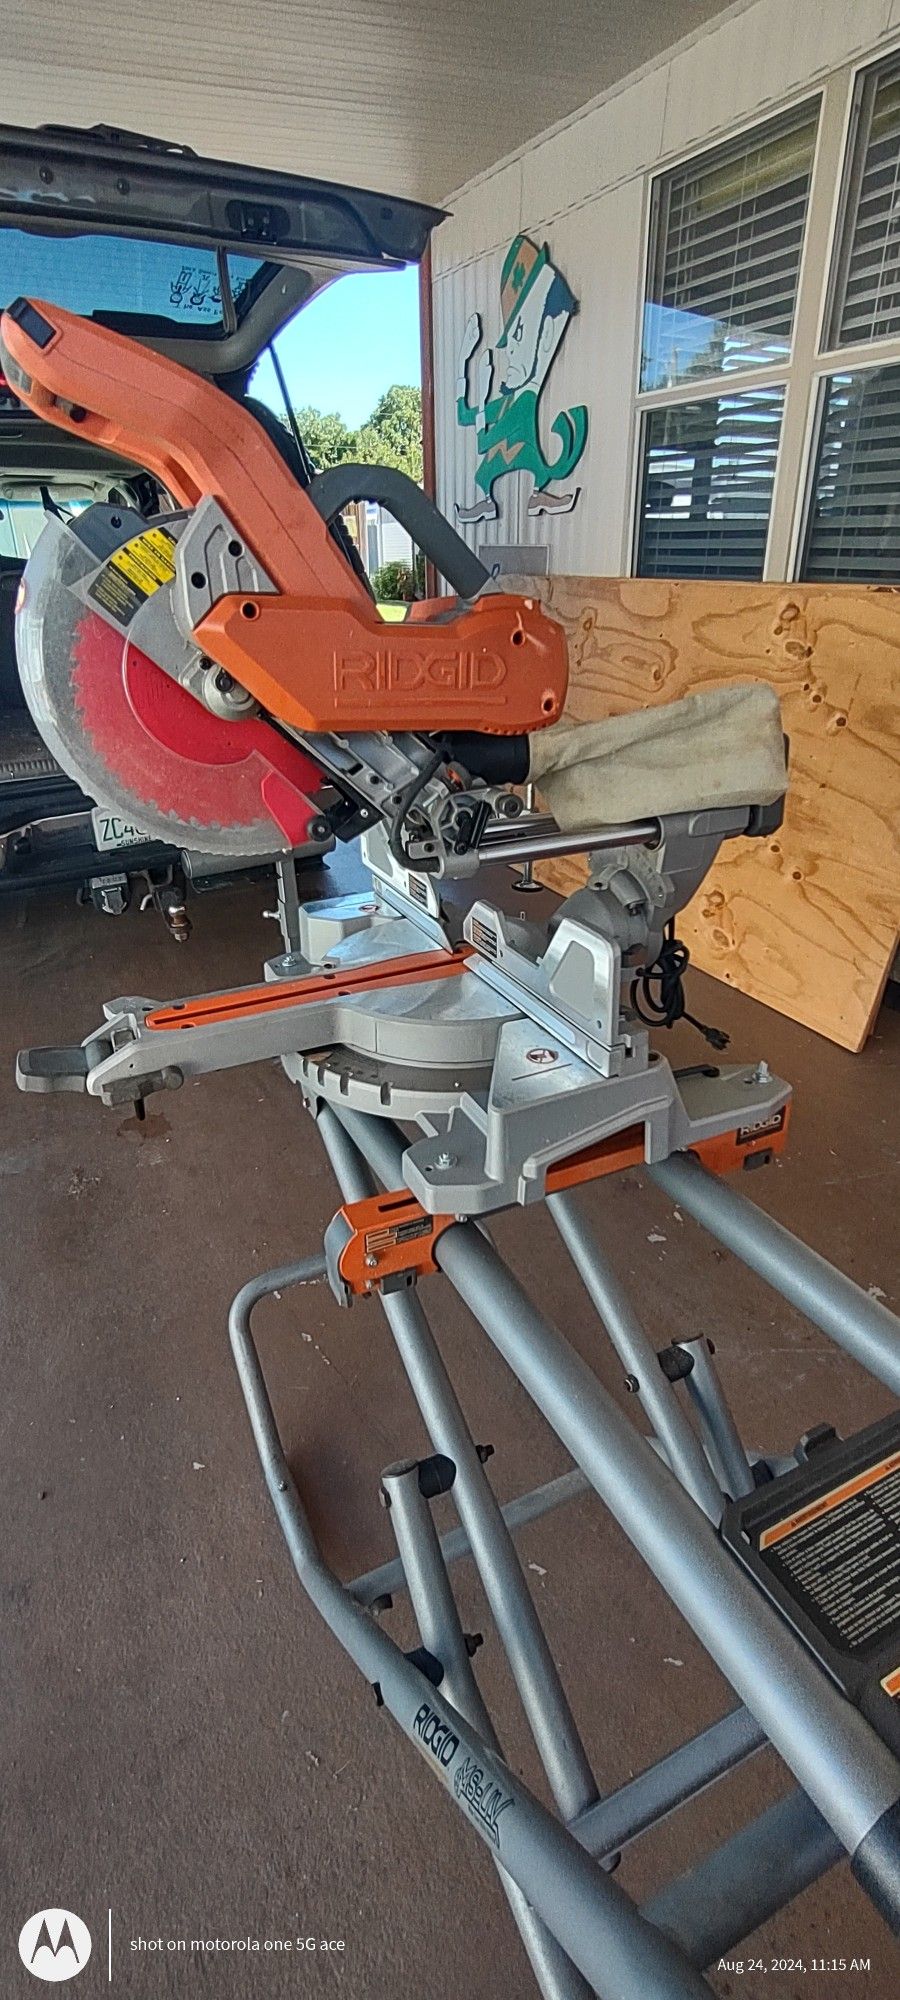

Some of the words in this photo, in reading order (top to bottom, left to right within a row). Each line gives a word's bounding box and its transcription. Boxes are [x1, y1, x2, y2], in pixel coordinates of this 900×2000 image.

[333, 650, 507, 691] RIDGID
[99, 817, 146, 842] ZC4
[413, 1703, 460, 1768] RIDGID
